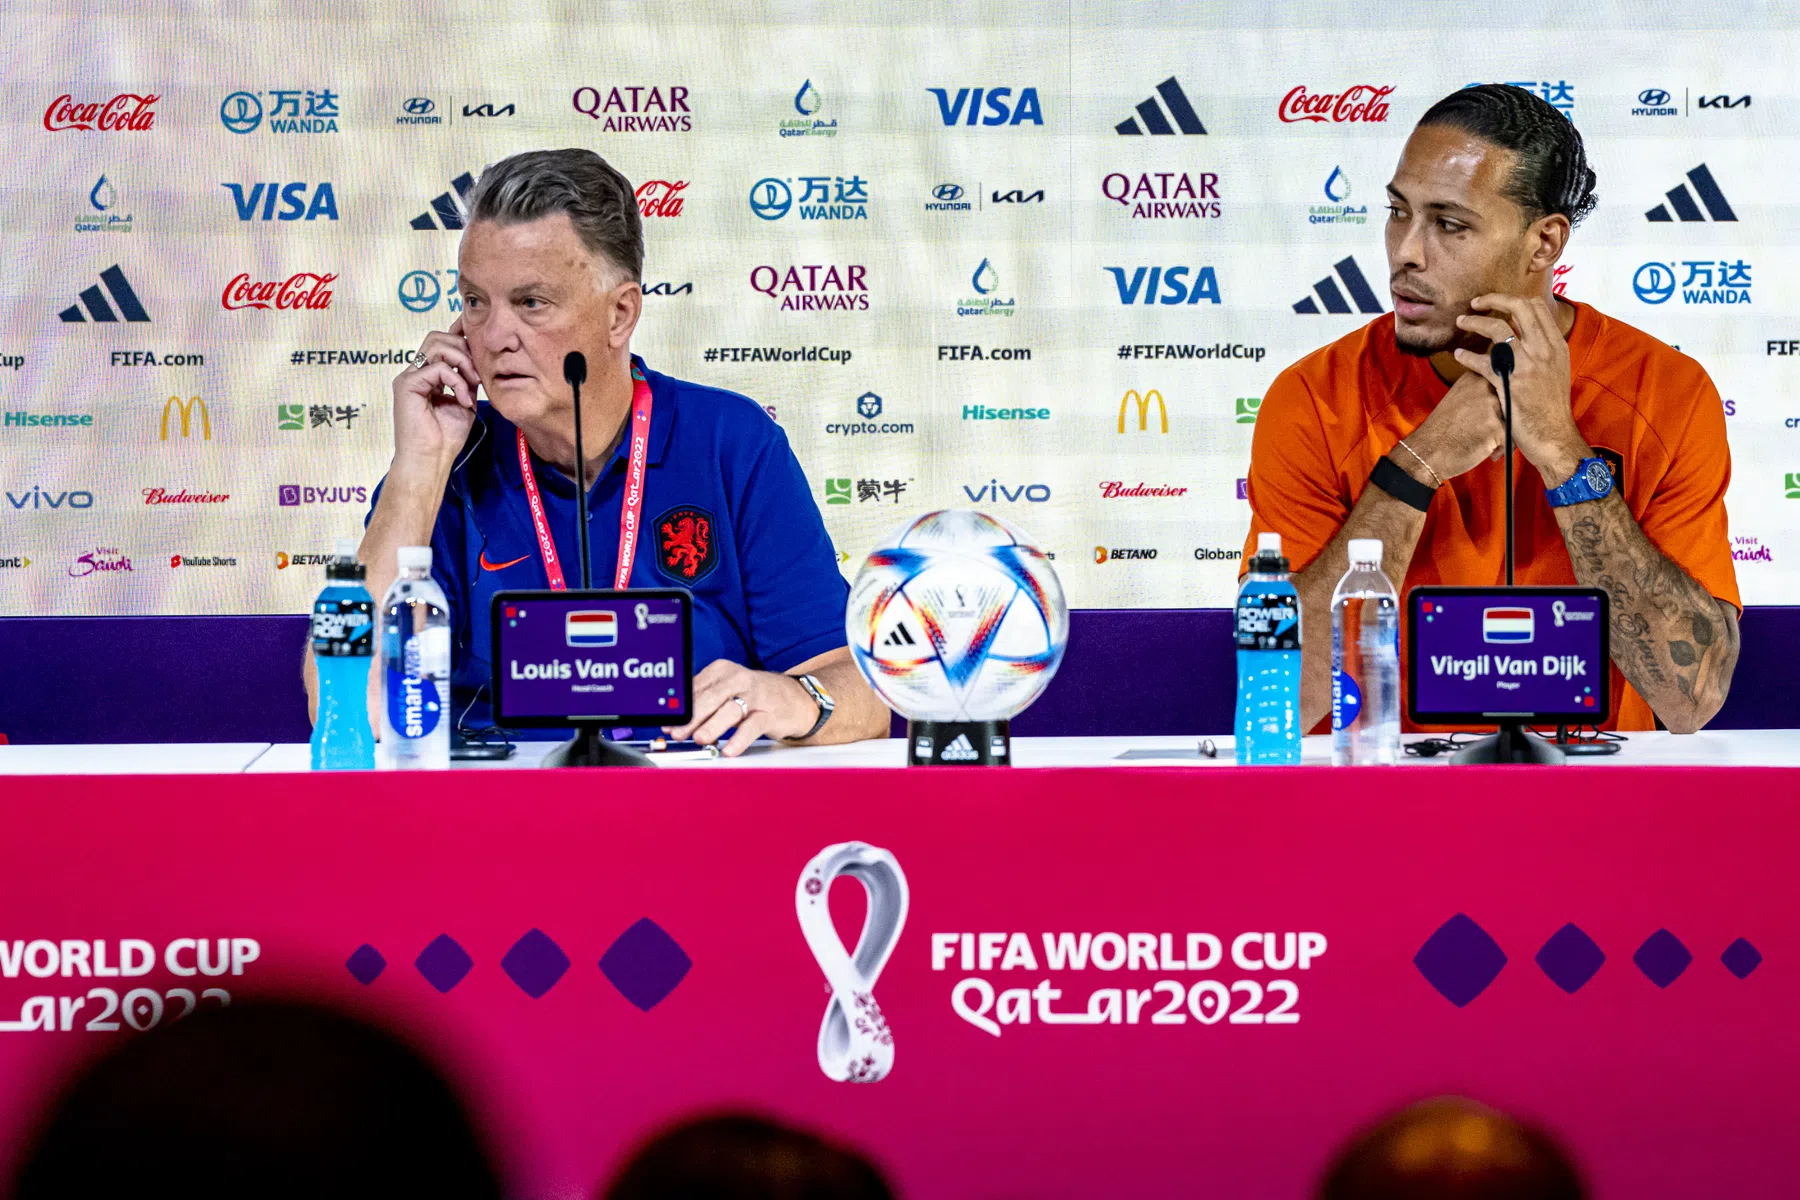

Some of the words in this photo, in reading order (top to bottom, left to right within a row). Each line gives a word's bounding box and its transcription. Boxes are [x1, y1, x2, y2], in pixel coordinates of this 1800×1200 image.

[268, 89, 339, 117] 万达
[573, 86, 690, 120] QATAR
[926, 87, 1044, 126] VISA
[1279, 84, 1396, 124] Coca-Cola
[1631, 107, 1678, 117] HYUNDAI
[43, 93, 161, 132] Coca-Cola
[396, 116, 442, 125] HYUNDAI
[270, 118, 339, 134] WANDA
[602, 116, 691, 133] AIRWAYS
[779, 128, 837, 138] QatarEnergy
[798, 175, 868, 203] 万达
[1102, 172, 1220, 205] QATAR
[221, 182, 339, 221] VISA
[925, 202, 971, 211] HYUNDAI
[1132, 202, 1221, 219] AIRWAYS
[800, 204, 868, 220] WANDA
[1309, 214, 1367, 224] QatarEnergy
[750, 265, 868, 298] QATAR
[1681, 260, 1752, 288] 万达
[221, 272, 339, 310] Coca-Cola
[1103, 266, 1221, 305] VISA
[780, 295, 869, 311] AIRWAYS
[1683, 289, 1752, 304] WANDA
[957, 306, 1015, 317] QatarEnergy
[111, 351, 204, 367] FIFA.com
[290, 349, 416, 365] #FIFAWorldC
[704, 346, 852, 365] #FIFAWorldCup
[937, 345, 1031, 361] FIFA.com
[1117, 343, 1266, 362] #FIFAWorldCup
[5, 411, 93, 427] Hisense
[962, 405, 1050, 420] Hisense
[825, 419, 914, 436] crypto.com
[627, 437, 644, 507] Qatar2022
[6, 485, 93, 509] vivo
[142, 487, 229, 505] Budweiser
[303, 486, 367, 503] BYJU'S
[856, 478, 907, 504] 蒙牛
[963, 479, 1050, 502] vivo
[1099, 481, 1188, 499] Budweiser
[525, 471, 535, 492] CUP
[531, 495, 555, 564] Qatar2022
[625, 510, 636, 530] CUP
[622, 531, 634, 567] WORLD
[1734, 536, 1758, 545] Visit
[182, 556, 211, 566] YouTube
[212, 556, 236, 566] Shorts
[292, 554, 334, 565] BETAN
[1111, 549, 1157, 560] BETANO
[1194, 548, 1242, 560] Globan
[511, 659, 572, 680] Louis
[575, 658, 619, 679] Van
[623, 657, 674, 678] Gaal
[1431, 655, 1490, 680] Virgil
[1494, 656, 1537, 675] Van
[1543, 655, 1586, 680] Dijk
[164, 937, 260, 976] CUP
[931, 932, 1038, 971] FIFA
[1043, 932, 1222, 971] WORLD
[1231, 932, 1327, 970] CUP
[951, 976, 1301, 1037] Qatar2022
